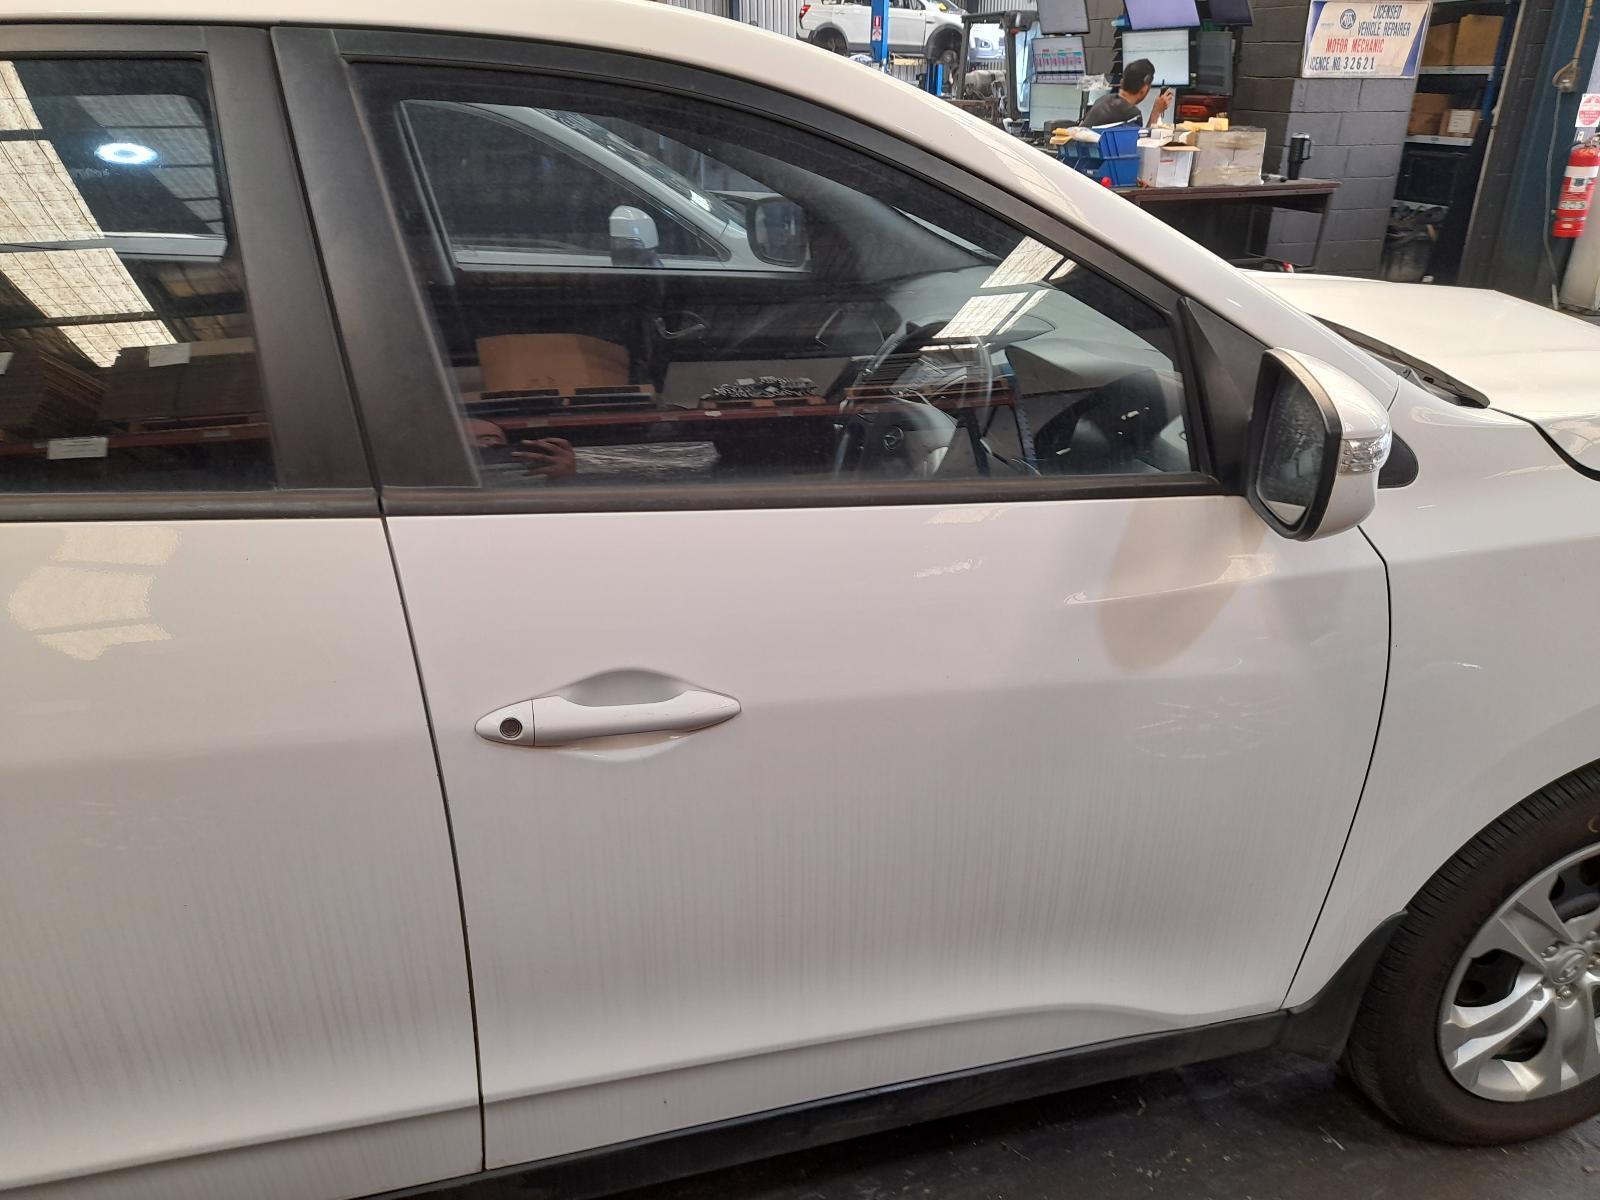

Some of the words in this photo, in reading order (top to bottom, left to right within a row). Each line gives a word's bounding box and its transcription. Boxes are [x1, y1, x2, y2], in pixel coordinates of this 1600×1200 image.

[1373, 4, 1402, 19] LICENSED
[1357, 21, 1381, 36] VEHICLE
[1382, 22, 1411, 37] REPAIRER
[1325, 38, 1349, 53] MOTOR
[1351, 38, 1385, 53] MECHANIC
[1307, 56, 1331, 71] ICENCE
